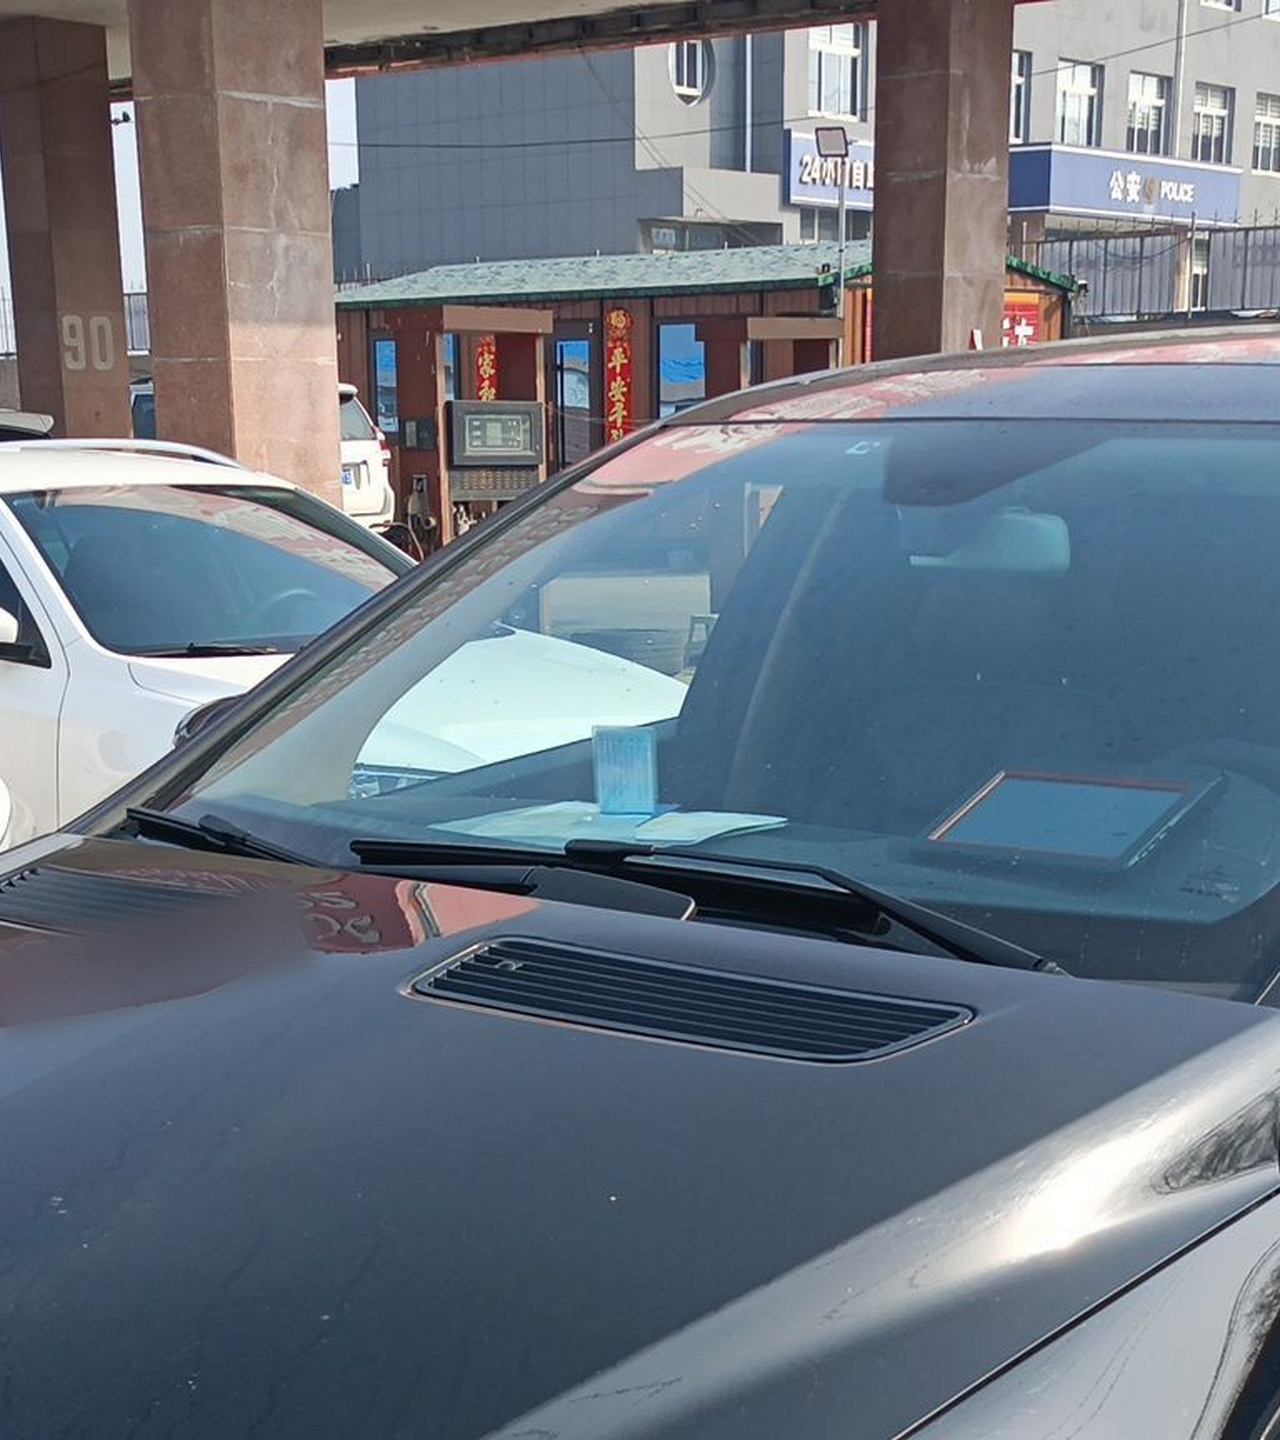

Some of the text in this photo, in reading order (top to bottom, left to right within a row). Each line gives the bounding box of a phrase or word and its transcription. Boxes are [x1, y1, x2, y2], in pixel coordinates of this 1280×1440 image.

[1109, 170, 1195, 203] 公安 POLICE
[62, 315, 115, 370] 90
